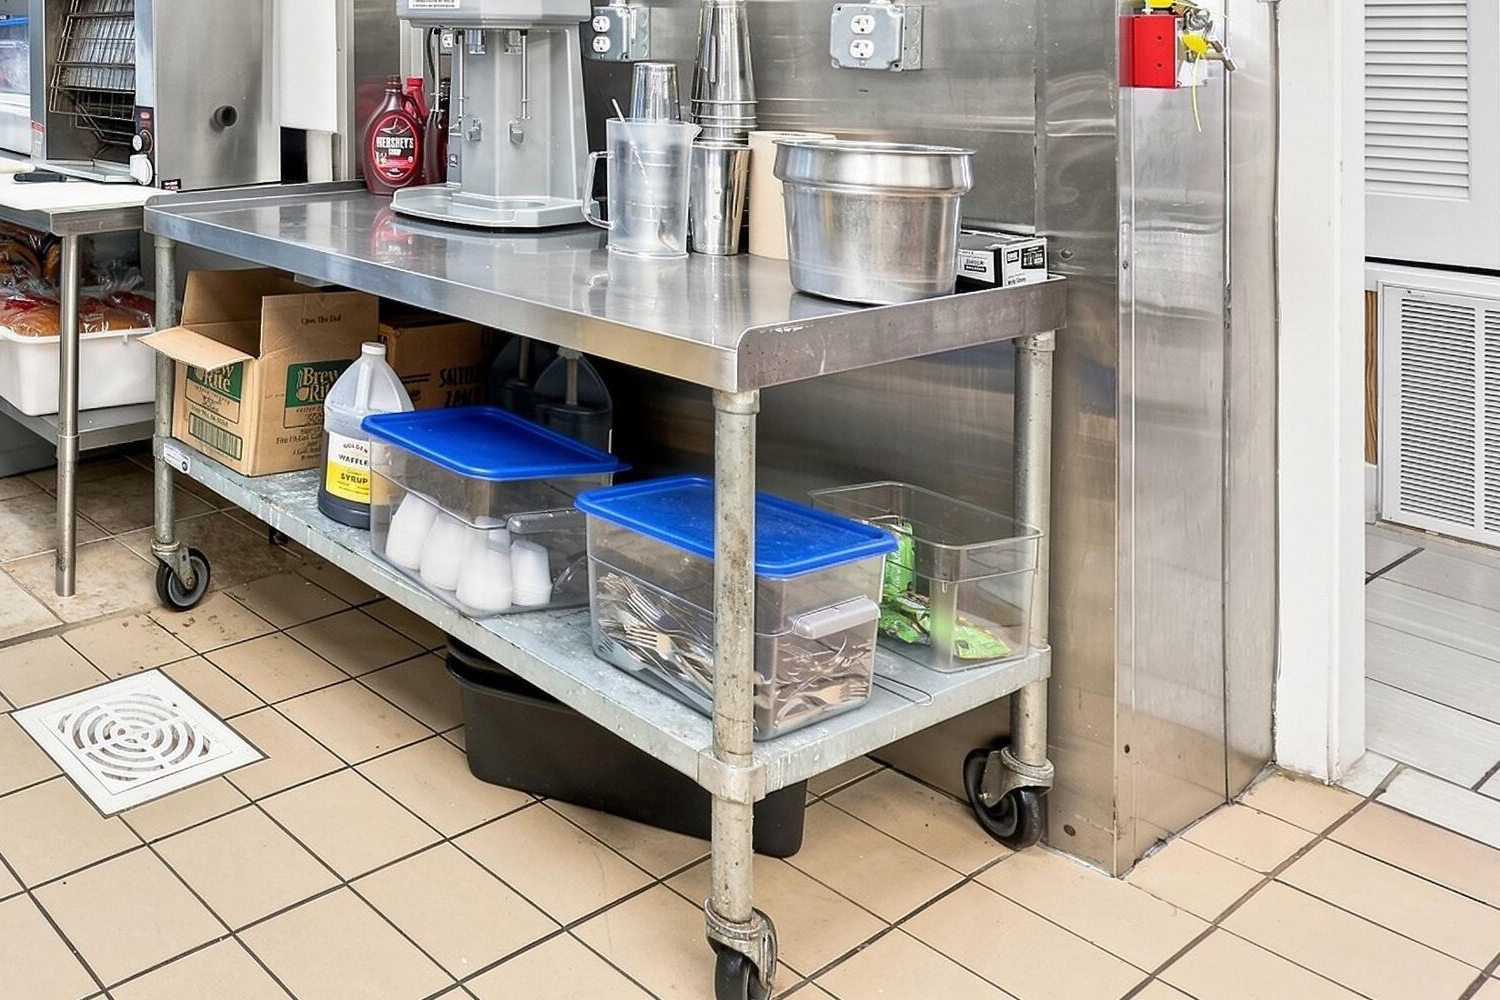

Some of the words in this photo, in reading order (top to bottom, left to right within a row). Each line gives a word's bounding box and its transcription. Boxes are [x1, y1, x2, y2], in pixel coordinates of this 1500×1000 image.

[343, 442, 369, 454] GOLDEN
[338, 453, 369, 466] WAFFLE
[340, 472, 368, 484] SYRUP
